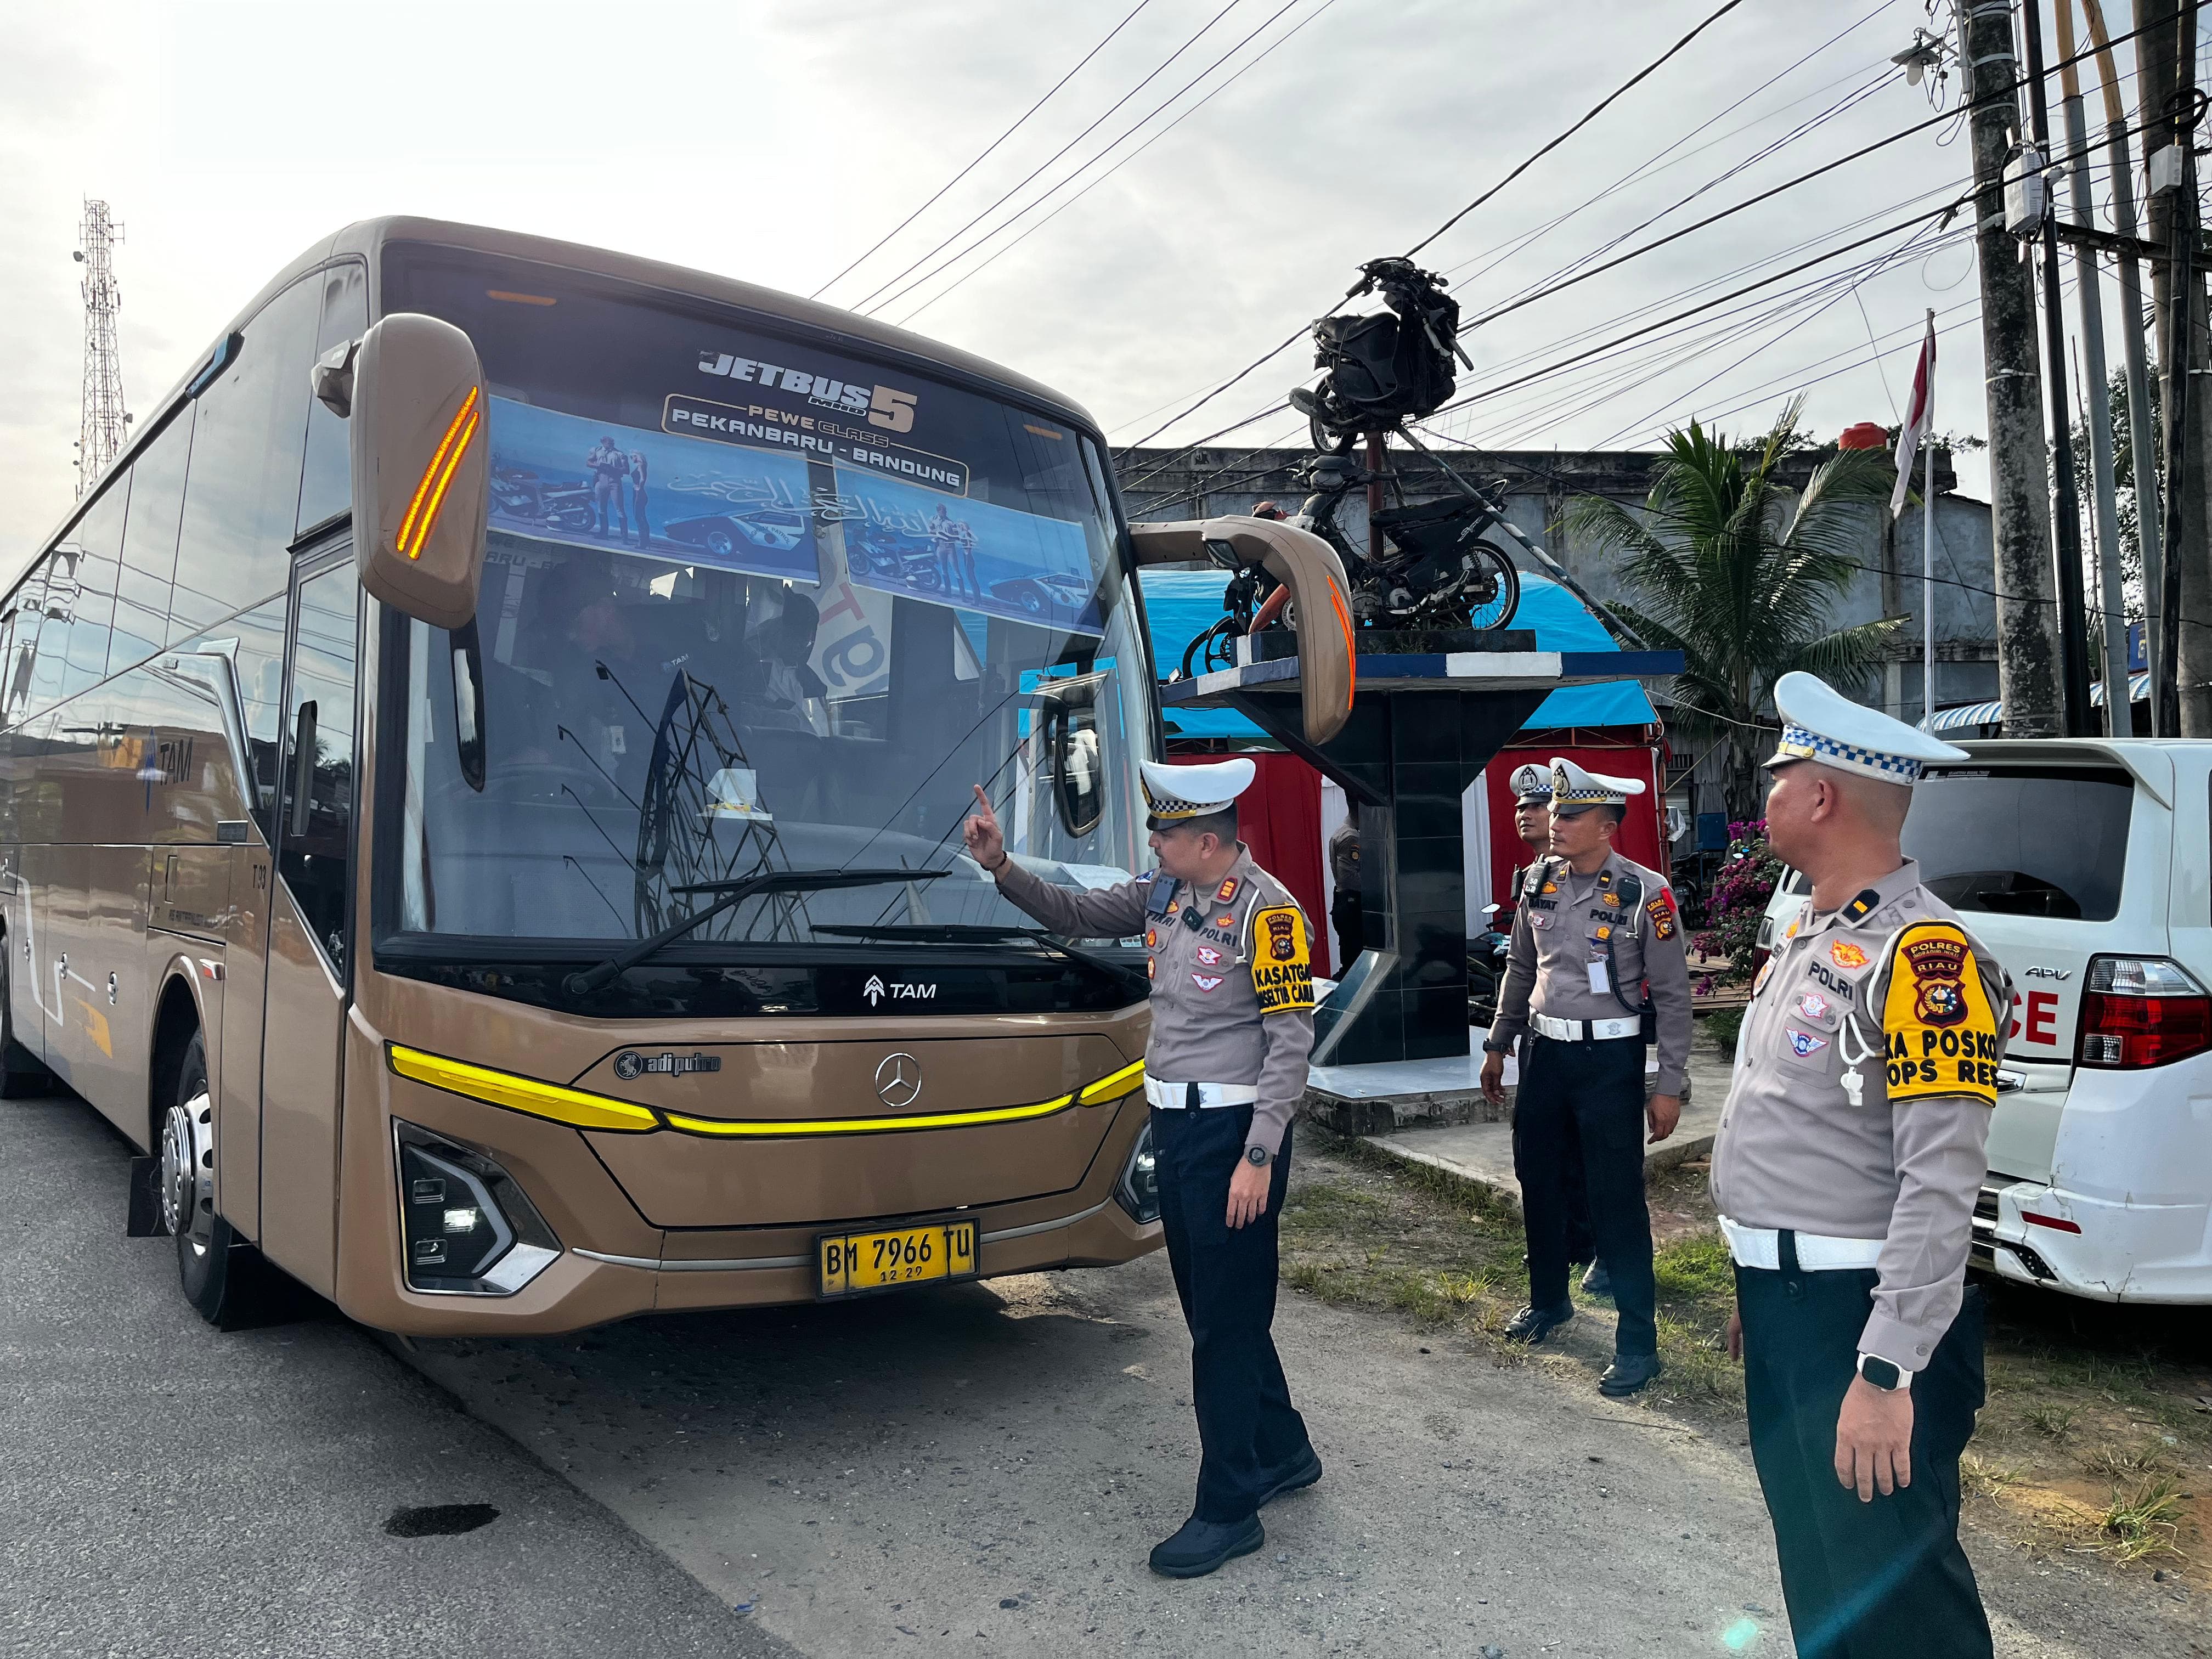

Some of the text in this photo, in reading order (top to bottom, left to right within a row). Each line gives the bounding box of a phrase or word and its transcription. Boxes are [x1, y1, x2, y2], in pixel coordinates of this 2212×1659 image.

[698, 350, 917, 433] JETBUS 5
[808, 396, 866, 416] MHD
[749, 405, 888, 448] PEWE CLASS
[672, 408, 833, 454] PEKANBARU
[853, 447, 961, 487] BANDUNG
[160, 737, 194, 786] TAM
[1654, 911, 1669, 919] RIAU
[1199, 927, 1237, 947] POLRI
[1910, 942, 1961, 954] POLRES
[1808, 961, 1853, 1001] POLRI
[1917, 962, 1957, 972] RIAU
[2025, 966, 2072, 980] APV
[890, 984, 936, 998] TAM
[1922, 1029, 1997, 1062] POSKO
[1887, 1059, 1998, 1088] OPS RES
[827, 1228, 969, 1275] BM 7966 TU
